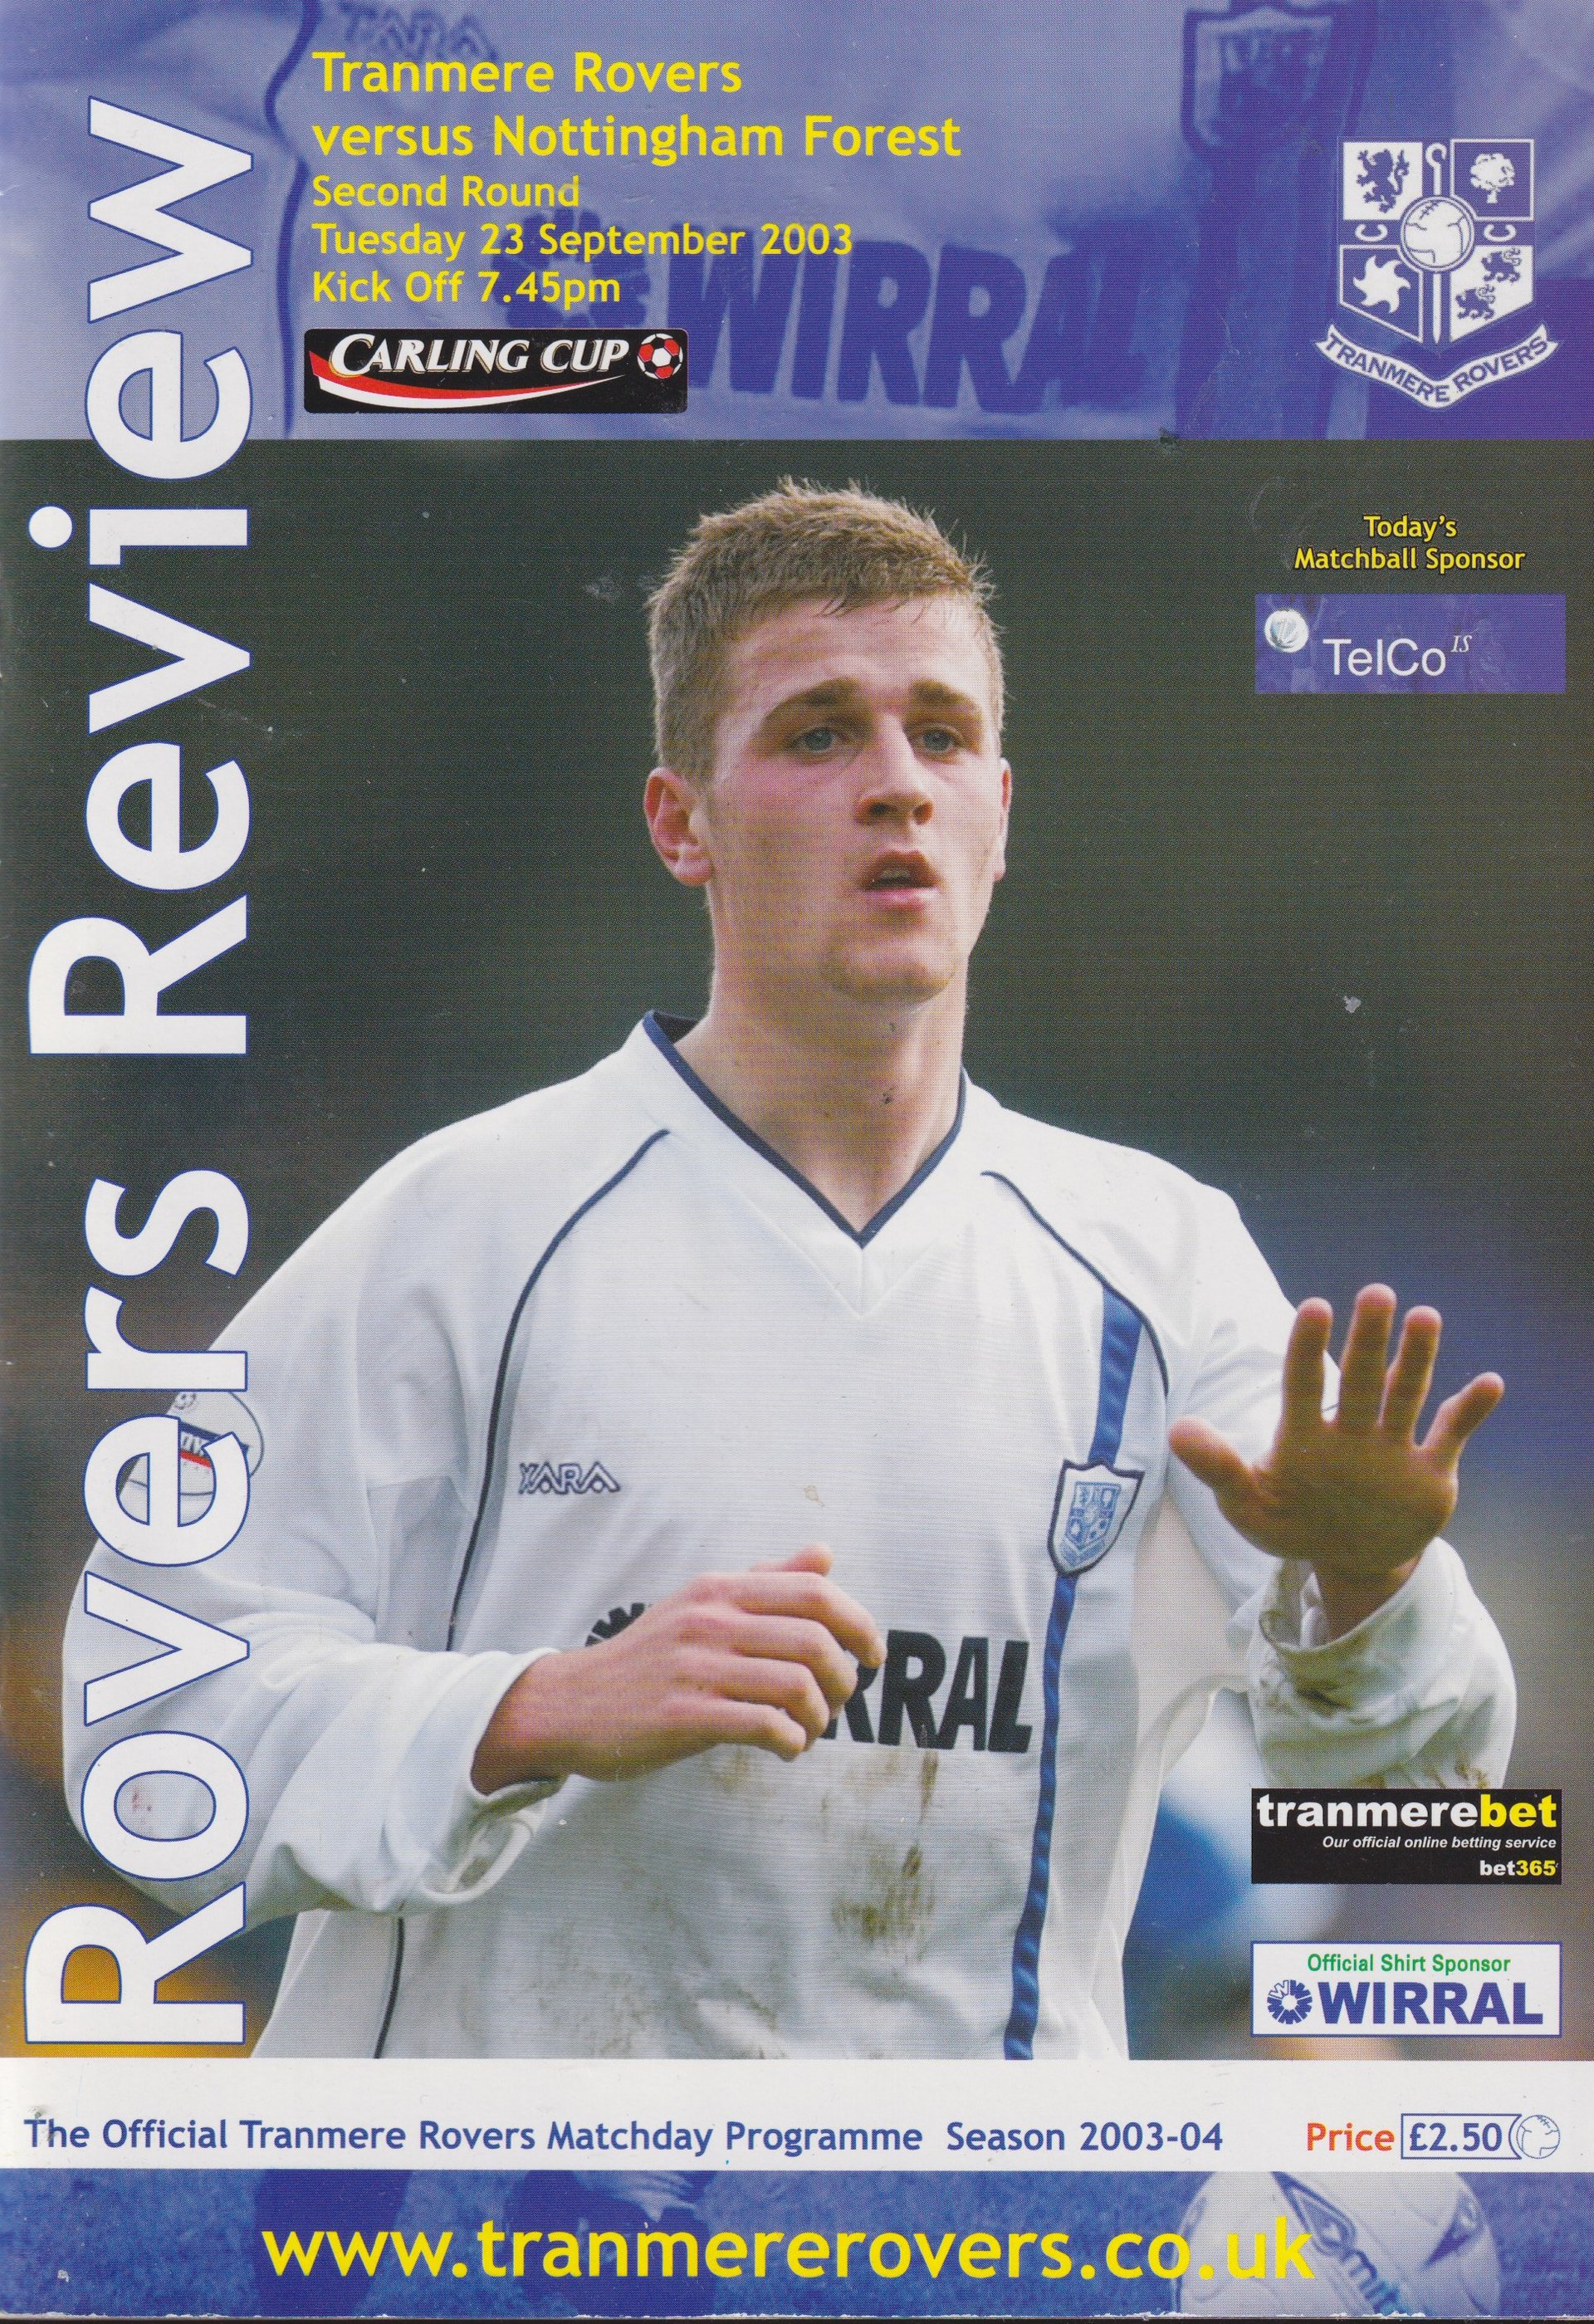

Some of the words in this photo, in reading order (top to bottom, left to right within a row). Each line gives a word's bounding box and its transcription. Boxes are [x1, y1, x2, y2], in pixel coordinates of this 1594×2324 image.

[313, 51, 555, 93] Tranmere
[575, 51, 743, 93] Rovers
[313, 125, 475, 157] versus
[495, 114, 785, 168] Nottingham
[806, 115, 963, 158] Forest
[314, 174, 448, 208] Second
[463, 174, 580, 208] Round
[313, 223, 467, 263] Tuesday
[482, 223, 525, 256] 23
[540, 223, 746, 263] September
[762, 223, 853, 256] 2003
[315, 271, 393, 303] Kick
[406, 271, 466, 303] Off
[479, 271, 621, 311] 7.45pm
[330, 334, 530, 376] CARLING
[542, 340, 629, 374] CUP
[1326, 333, 1450, 403] TRANMERE
[1451, 335, 1548, 393] ROVERS
[27, 95, 253, 1056] Review
[1295, 547, 1417, 570] Matchball
[1427, 548, 1526, 575] Sponsor
[1323, 638, 1446, 677] TelCo
[1451, 635, 1474, 653] IS
[23, 1167, 250, 2045] Rovers
[1257, 1793, 1558, 1828] tranmerebet
[1323, 1836, 1350, 1849] Our
[1352, 1836, 1401, 1849] official
[1405, 1836, 1448, 1849] online
[1452, 1836, 1502, 1851] betting
[1505, 1837, 1557, 1849] service
[1479, 1860, 1557, 1876] bet365
[1308, 1954, 1375, 1973] Official
[1381, 1954, 1426, 1973] Shirt
[1432, 1954, 1512, 1976] Sponsor
[1318, 1982, 1545, 2025] WIRRAL
[24, 2120, 90, 2149] The
[103, 2119, 228, 2150] Official
[240, 2121, 408, 2150] Tranmere
[420, 2121, 536, 2150] Rovers
[549, 2121, 714, 2157] Matchday
[727, 2121, 924, 2159] Programme
[948, 2121, 1067, 2152] Season
[1081, 2122, 1225, 2152] 2003-04
[1308, 2122, 1396, 2152] Price
[1411, 2122, 1504, 2152] £2.50
[262, 2215, 1317, 2280] www.tranmererovers.co.uk
